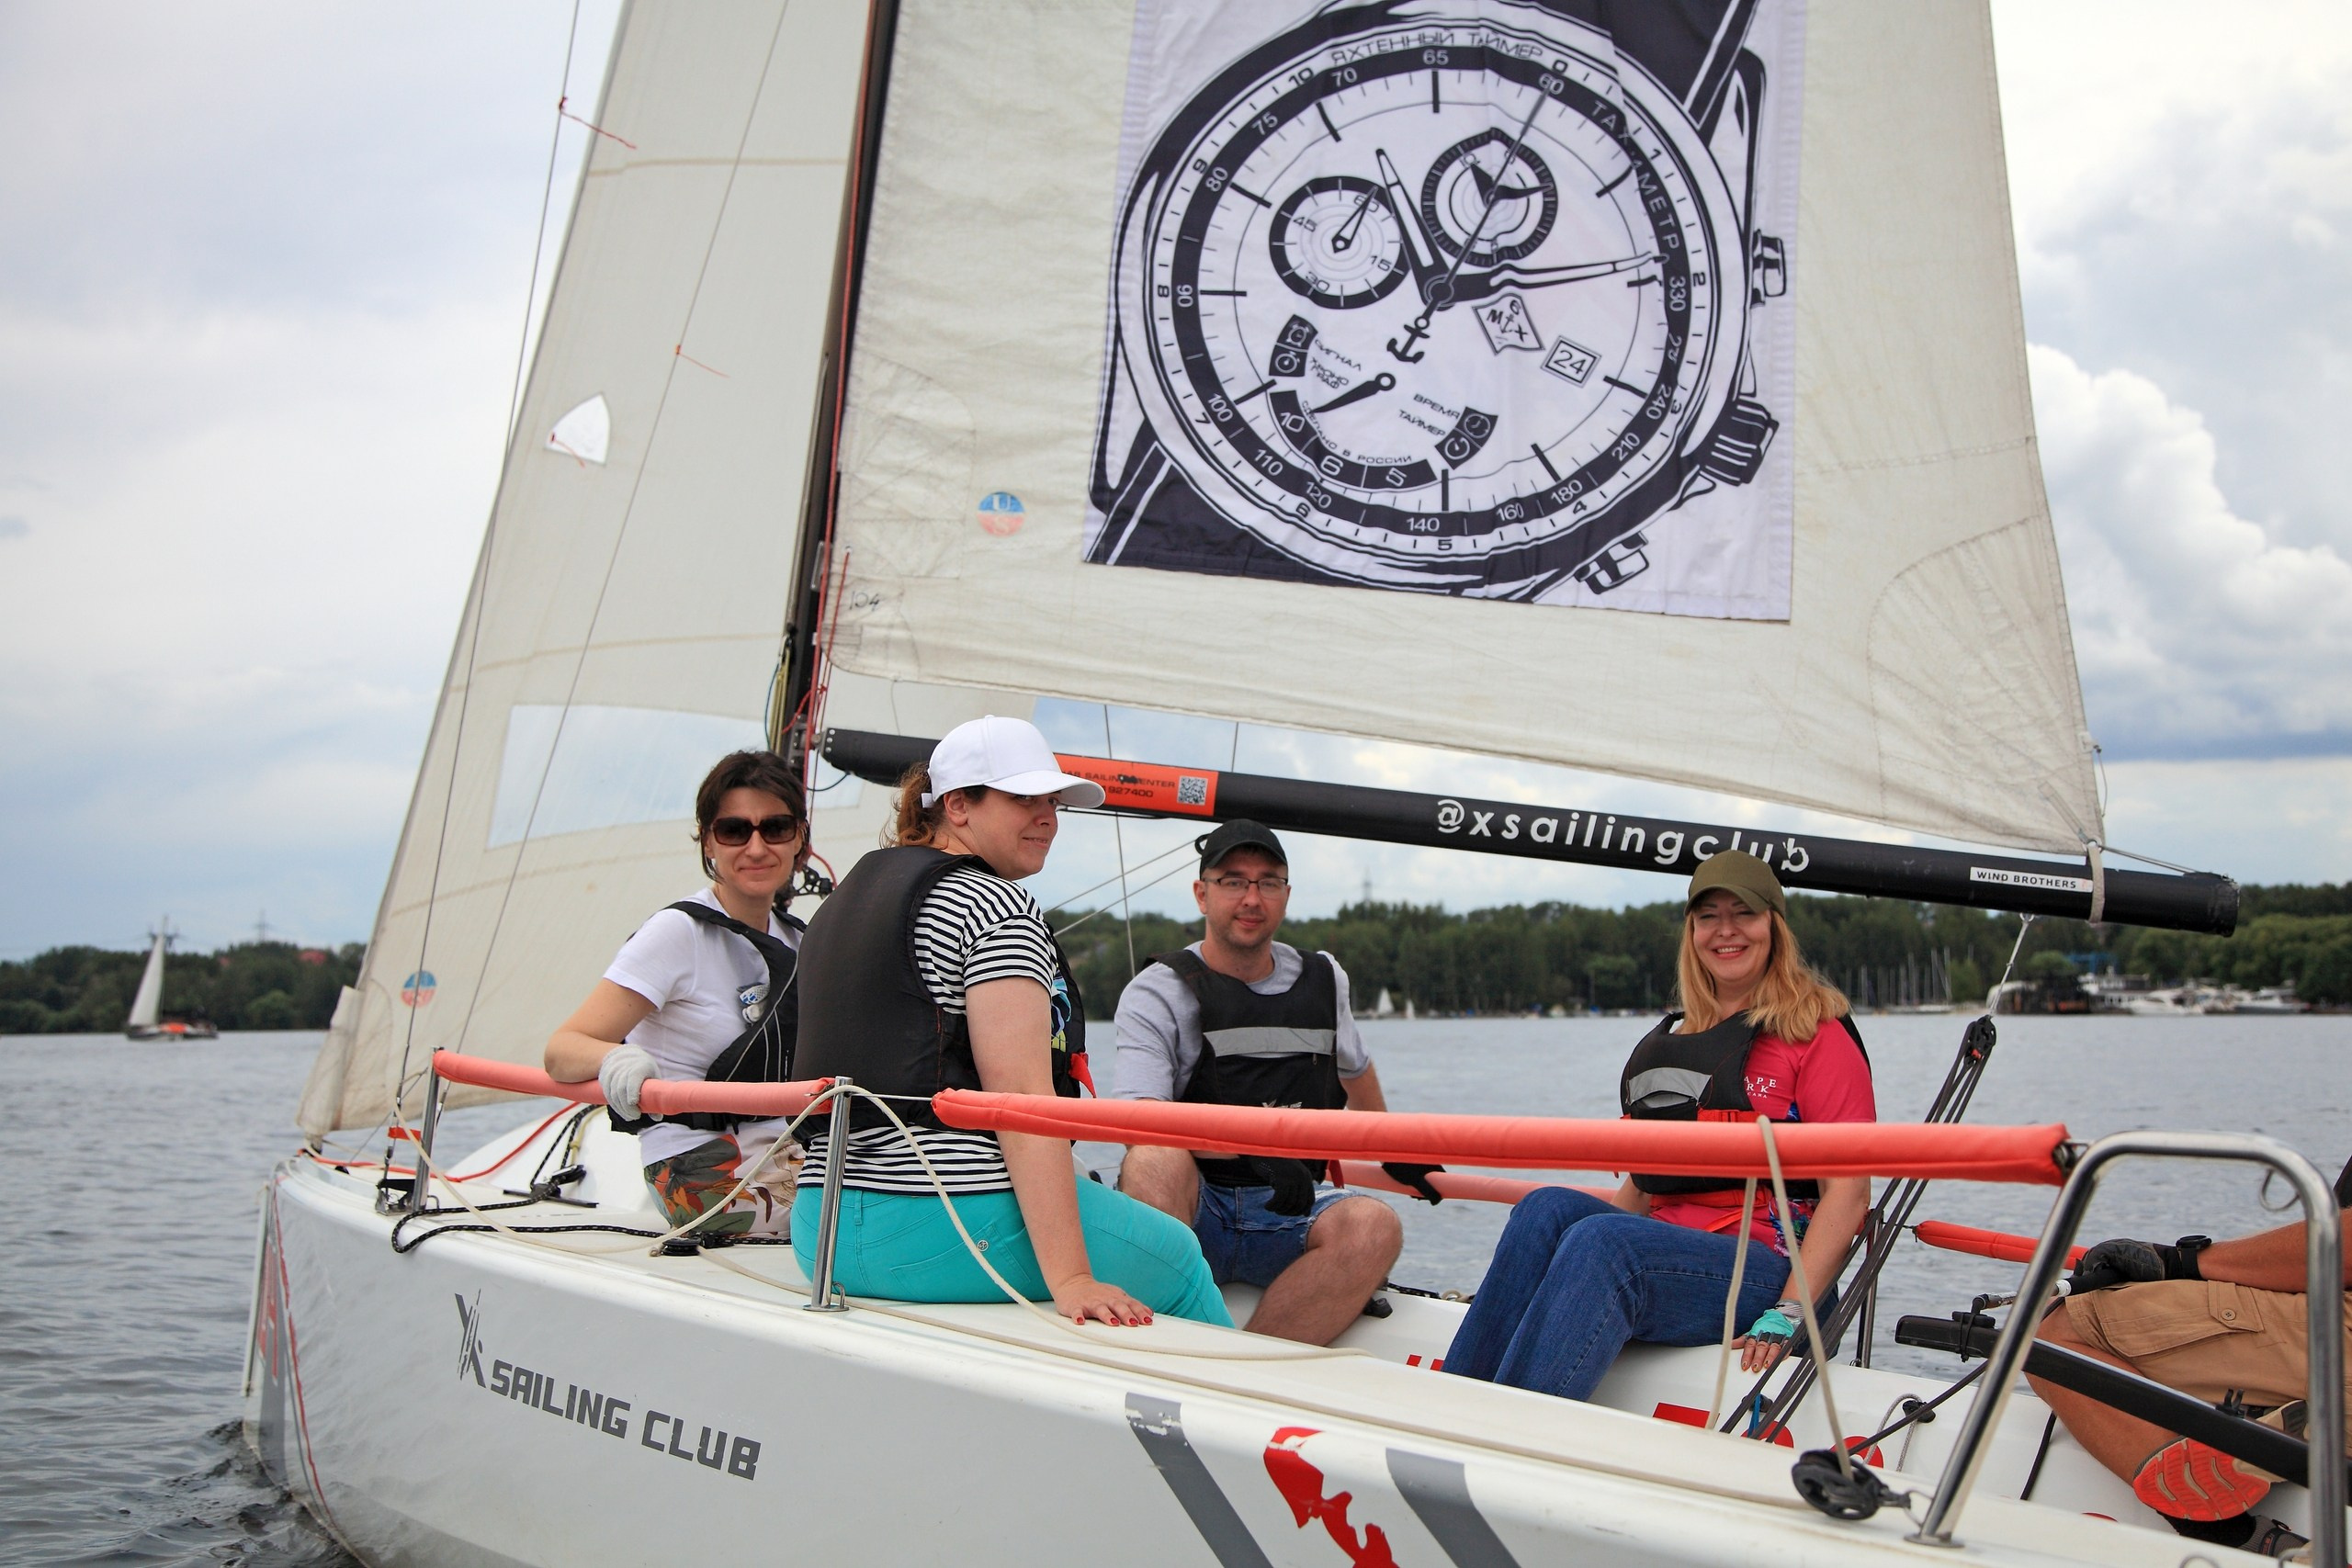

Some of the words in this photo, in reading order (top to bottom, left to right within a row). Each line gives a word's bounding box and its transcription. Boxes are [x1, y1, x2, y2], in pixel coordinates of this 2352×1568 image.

[1331, 28, 1454, 65] ЯХТЕННЫЙ
[1423, 49, 1449, 65] 65
[1288, 67, 1314, 88] 10
[1332, 67, 1358, 87] 70
[1251, 112, 1279, 136] 75
[1193, 158, 1207, 174] 9
[1205, 166, 1229, 192] 80
[1293, 216, 1317, 232] 45
[1370, 255, 1392, 272] 15
[1176, 283, 1193, 308] 90
[1668, 276, 1687, 312] 330
[1554, 350, 1586, 374] 24
[1206, 392, 1233, 423] 100
[1413, 394, 1462, 420] ВРЕМЯ
[1645, 383, 1672, 420] 240
[1281, 412, 1305, 433] 10
[1398, 410, 1446, 436] ТАЙМЕР
[1611, 432, 1641, 461] 210
[1254, 448, 1283, 477] 110
[1321, 455, 1344, 476] 6
[1358, 455, 1412, 465] РОССИИ
[1385, 468, 1408, 487] 5
[1306, 480, 1332, 509] 120
[1551, 479, 1583, 505] 180
[1496, 502, 1525, 522] 160
[1406, 517, 1440, 533] 140
[849, 591, 880, 613] 104
[1084, 772, 1121, 782] SAILIN
[1977, 871, 2008, 882] WIND
[2013, 874, 2076, 889] BROTHERS
[1744, 1076, 1777, 1088] APE
[491, 1359, 631, 1439] SAILING
[641, 1410, 762, 1481] CLUB
